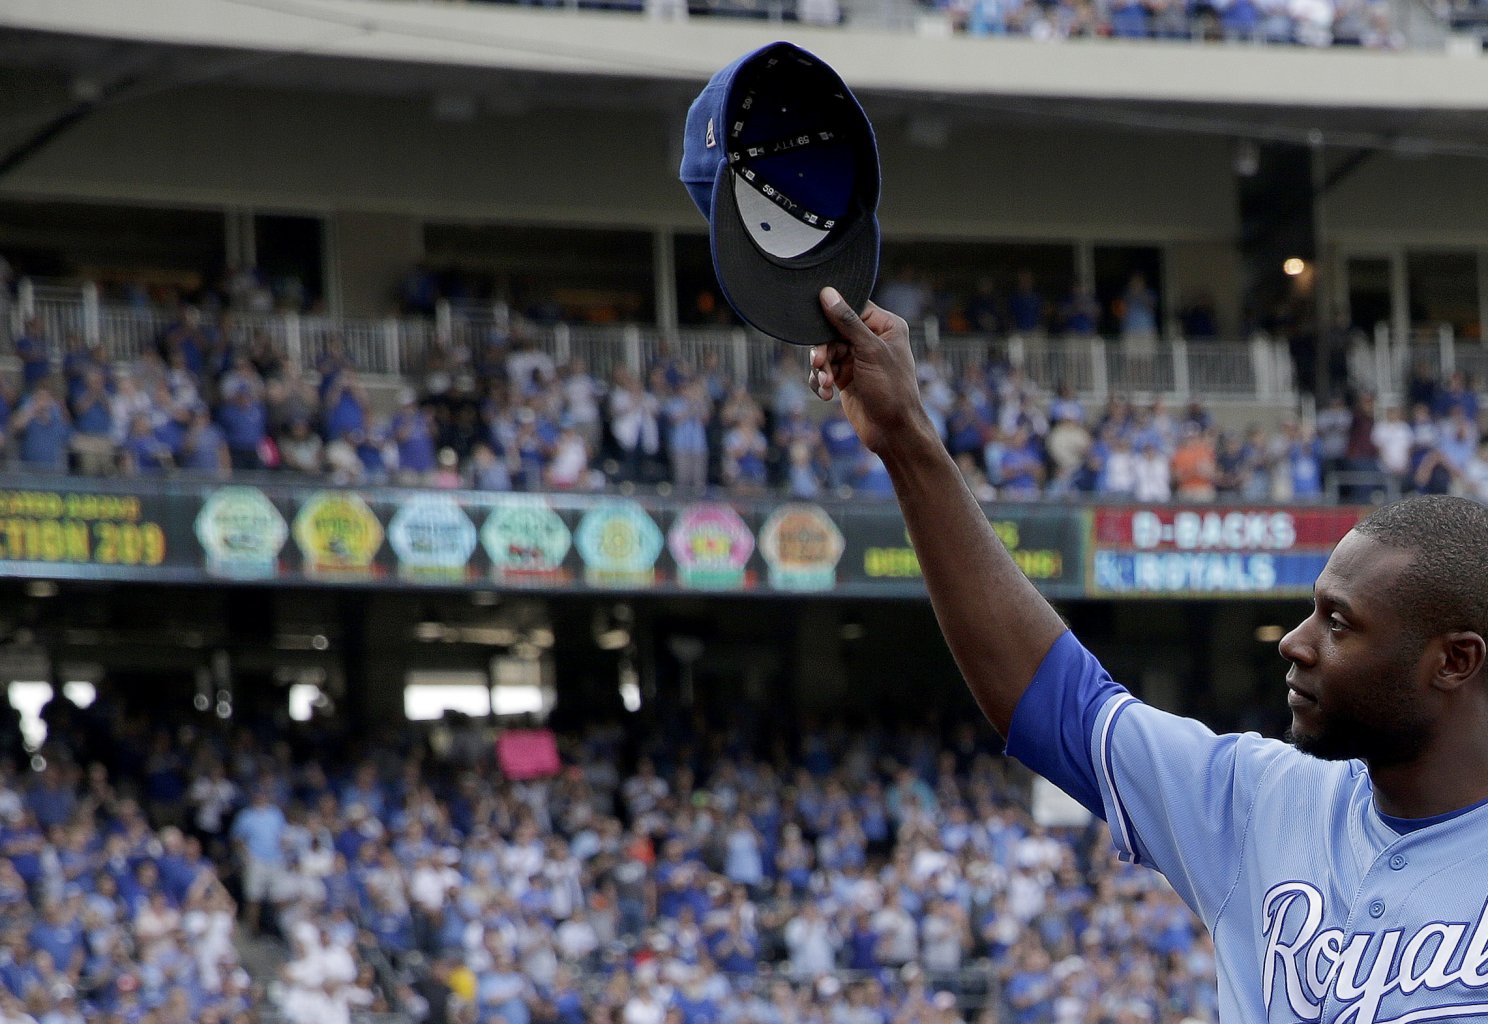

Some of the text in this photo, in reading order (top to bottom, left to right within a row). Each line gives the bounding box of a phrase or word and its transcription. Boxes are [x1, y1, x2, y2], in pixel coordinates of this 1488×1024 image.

[94, 519, 166, 567] 209
[1131, 511, 1297, 549] D-BACKS
[1134, 551, 1277, 591] ROYALS
